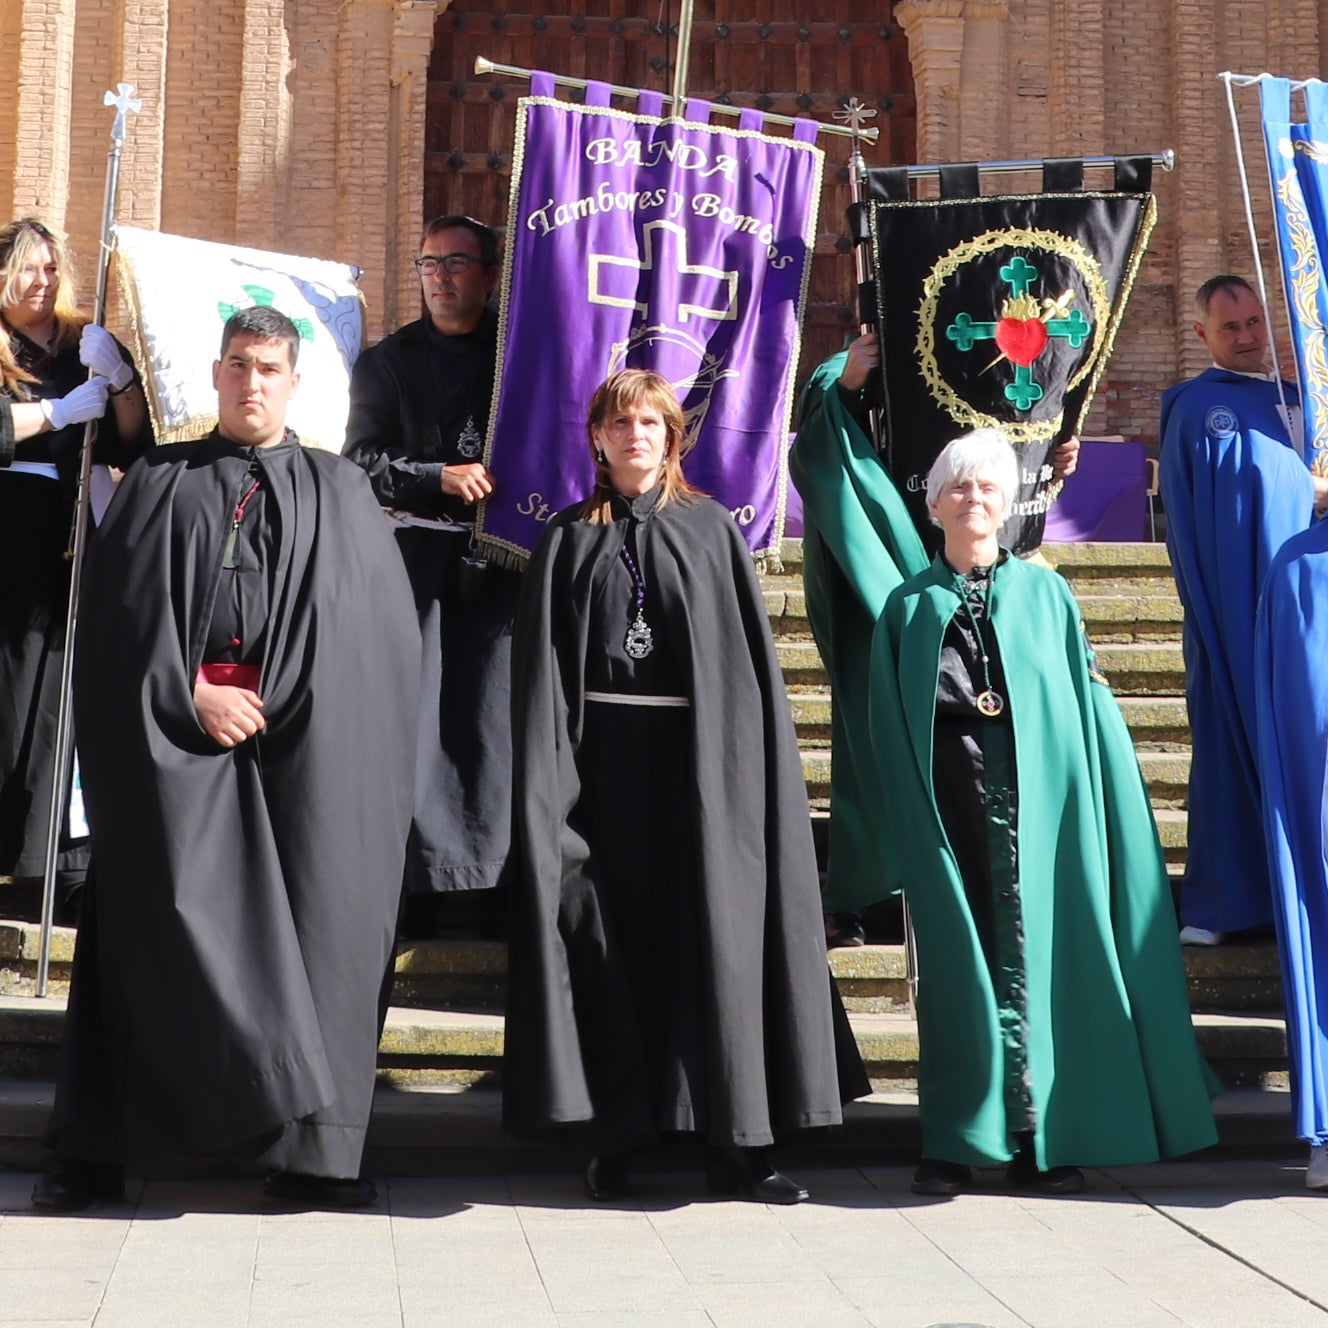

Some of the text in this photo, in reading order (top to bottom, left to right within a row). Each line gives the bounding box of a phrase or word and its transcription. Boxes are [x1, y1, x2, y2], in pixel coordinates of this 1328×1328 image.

[585, 137, 738, 183] BANDA
[527, 182, 794, 270] Tambores y Bombos
